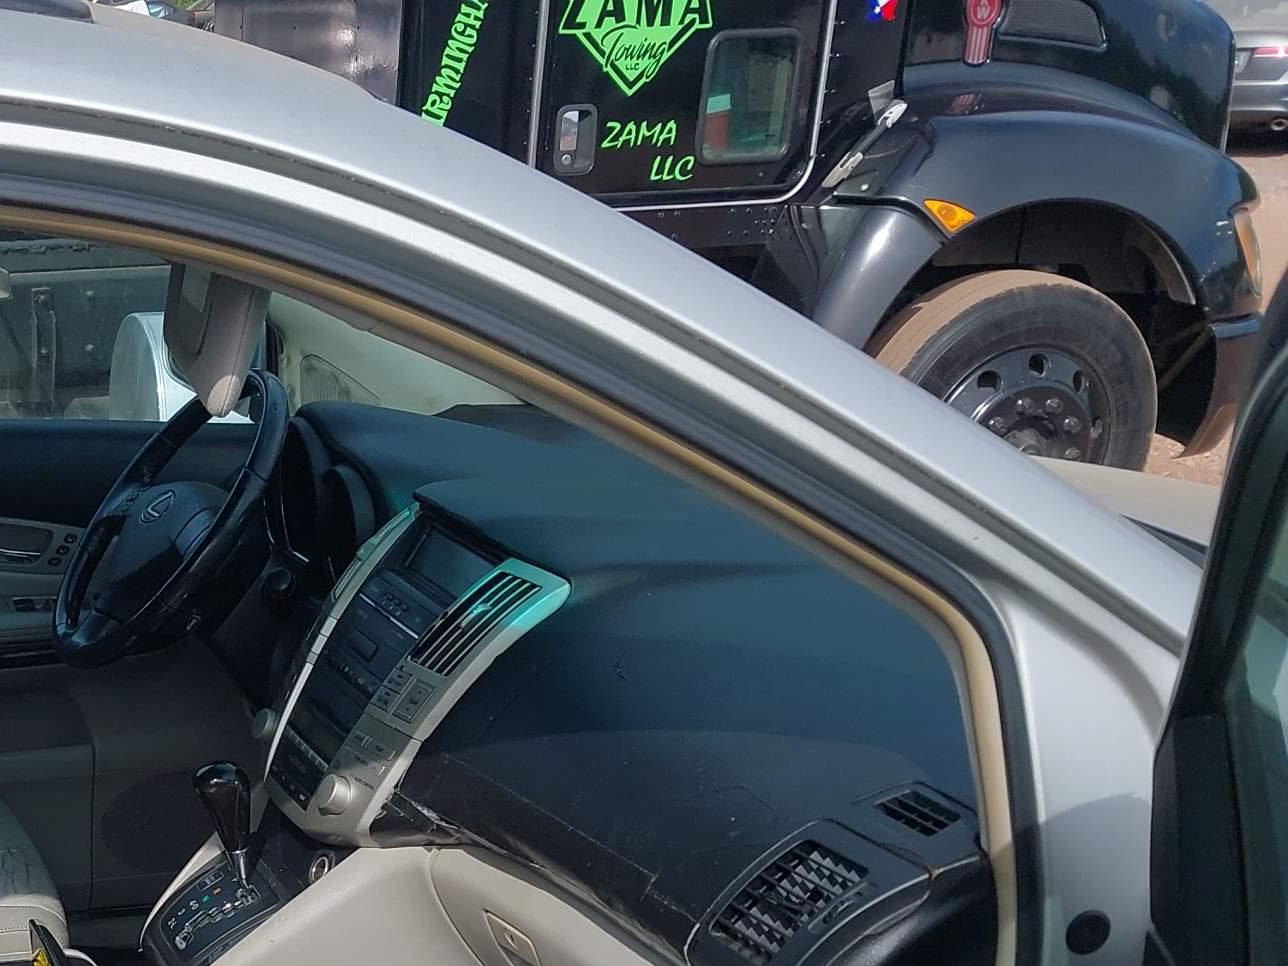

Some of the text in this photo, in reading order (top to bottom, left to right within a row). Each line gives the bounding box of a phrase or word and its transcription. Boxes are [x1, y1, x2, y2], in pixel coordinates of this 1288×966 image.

[600, 24, 668, 79] Towing
[625, 62, 641, 71] LLC
[600, 119, 678, 149] ZAMA
[649, 155, 696, 181] LLC
